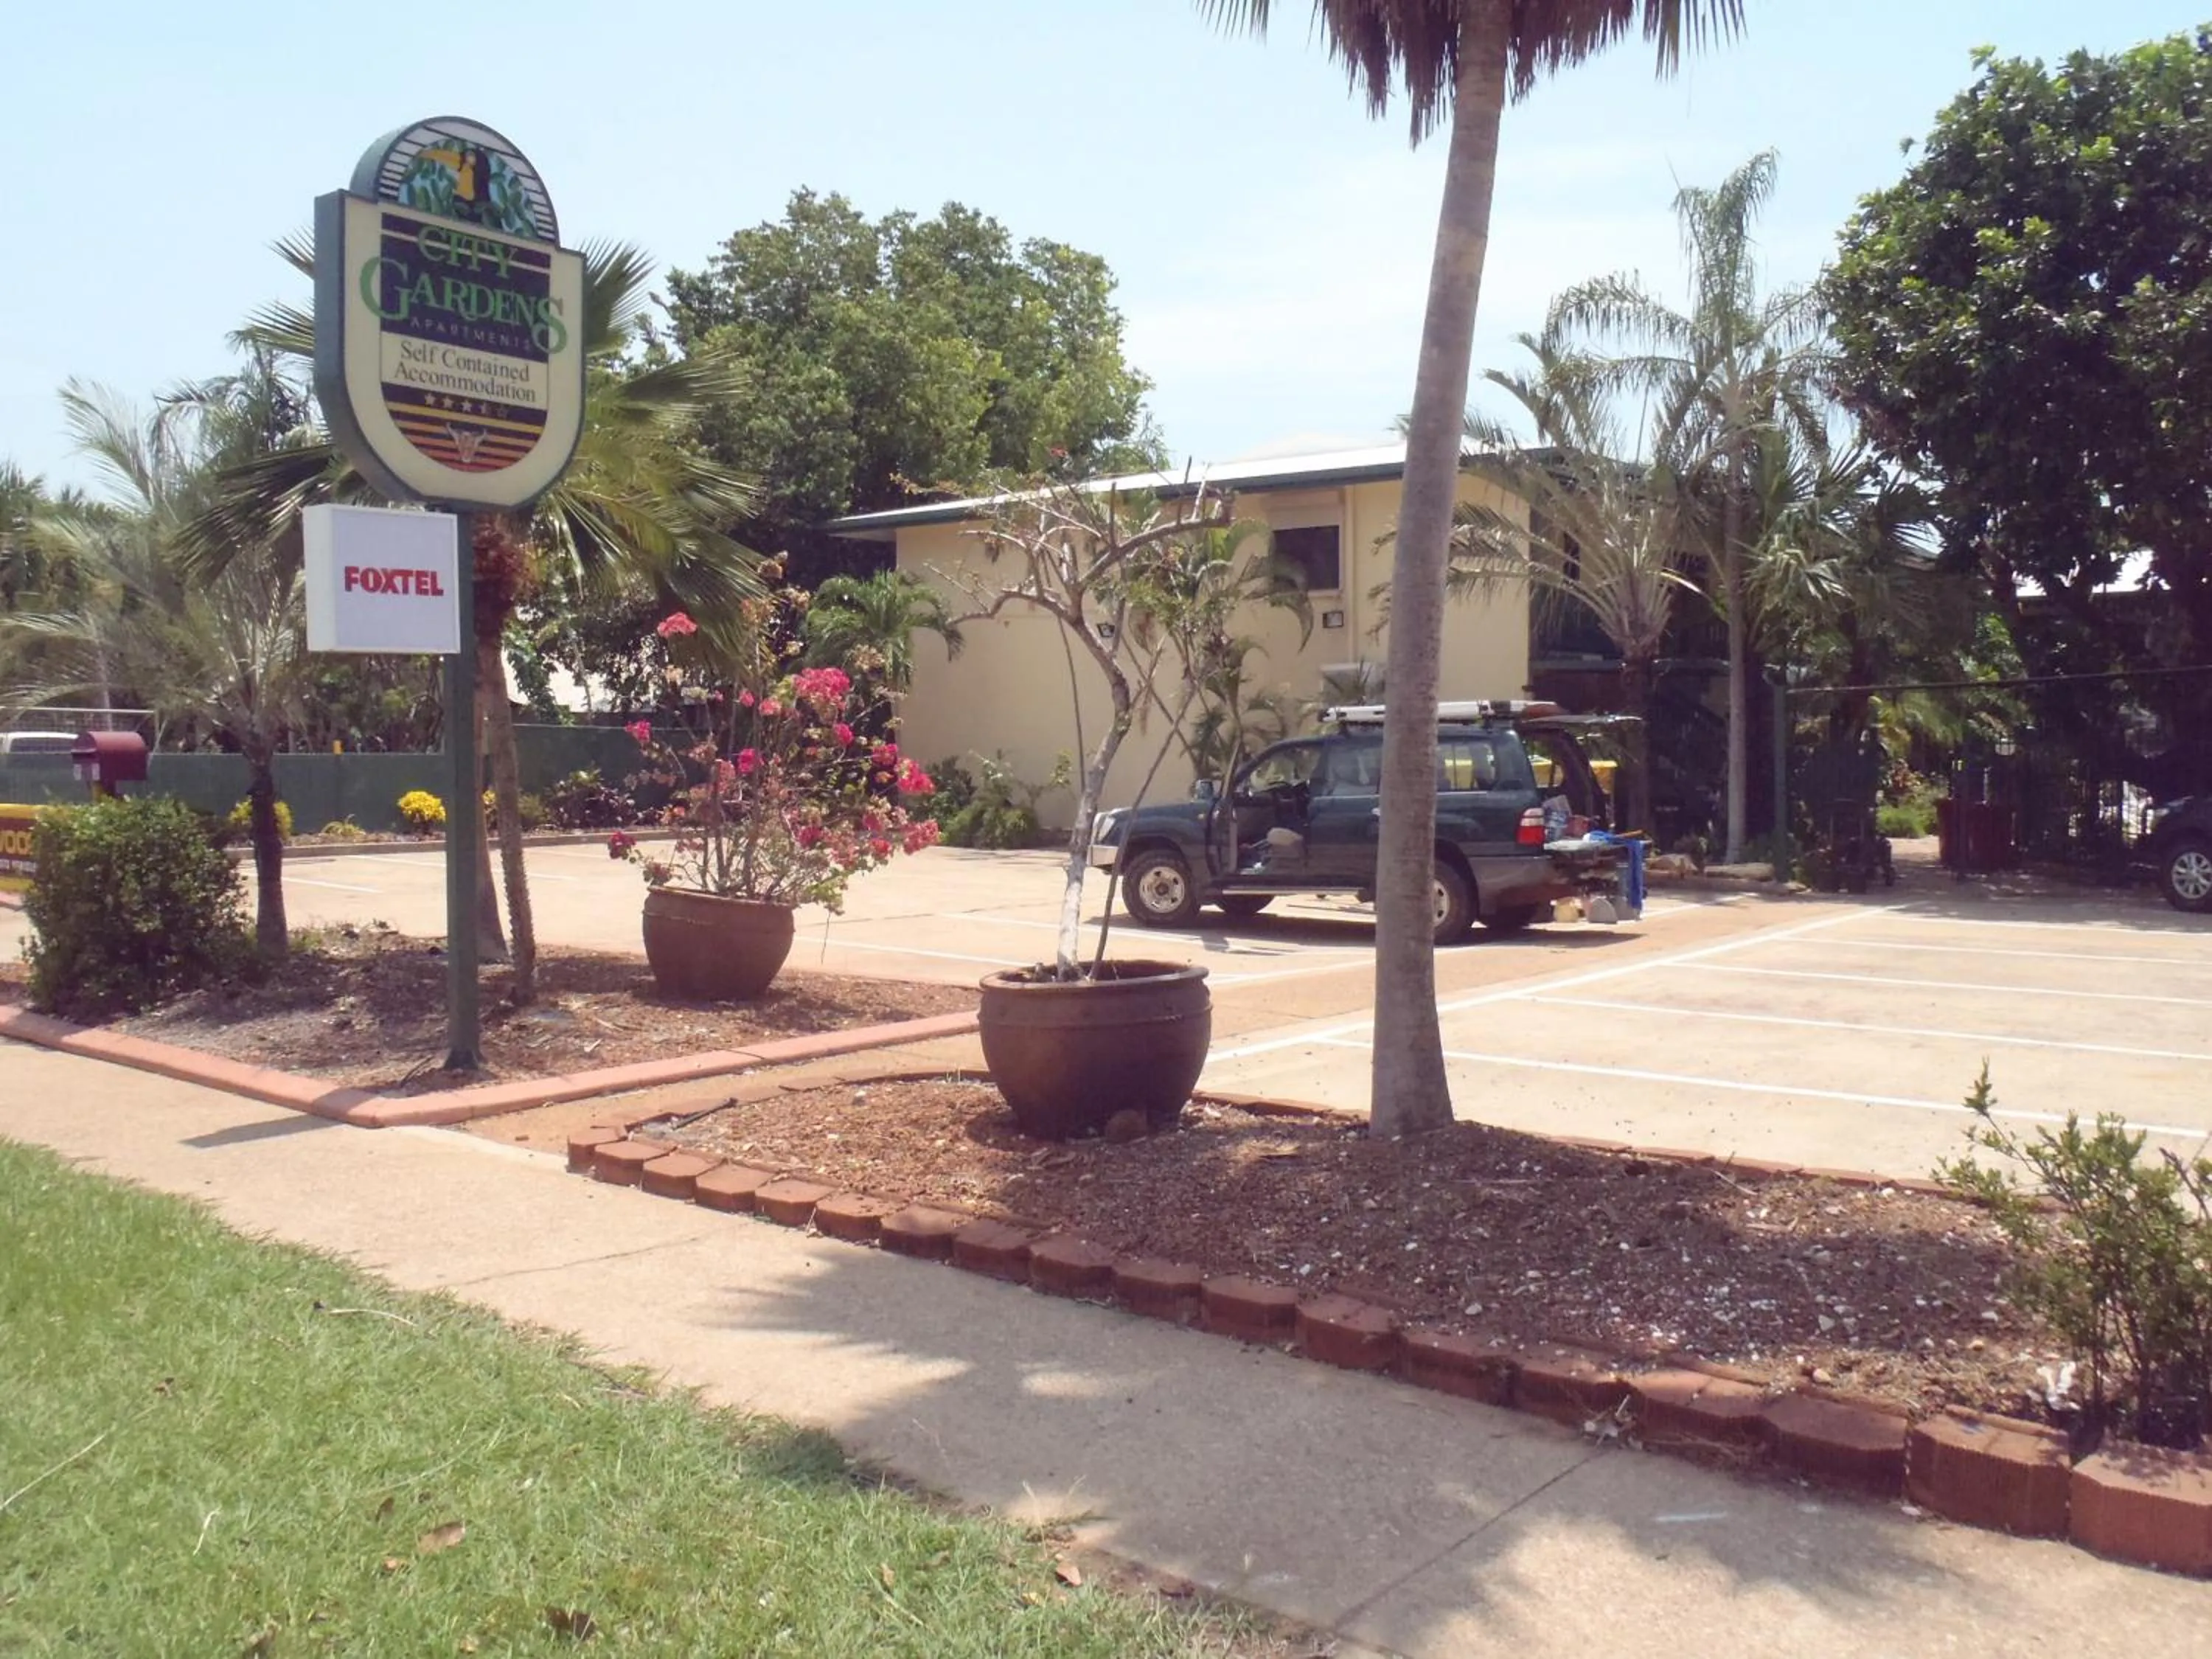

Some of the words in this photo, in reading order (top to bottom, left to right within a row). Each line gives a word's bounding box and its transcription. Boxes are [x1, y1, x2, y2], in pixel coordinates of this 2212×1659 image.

[417, 225, 518, 279] CITY
[360, 255, 568, 355] GARDENS
[394, 360, 536, 403] Accommodation
[400, 340, 439, 364] Self
[442, 347, 530, 383] Contained
[344, 566, 444, 597] FOXTEL
